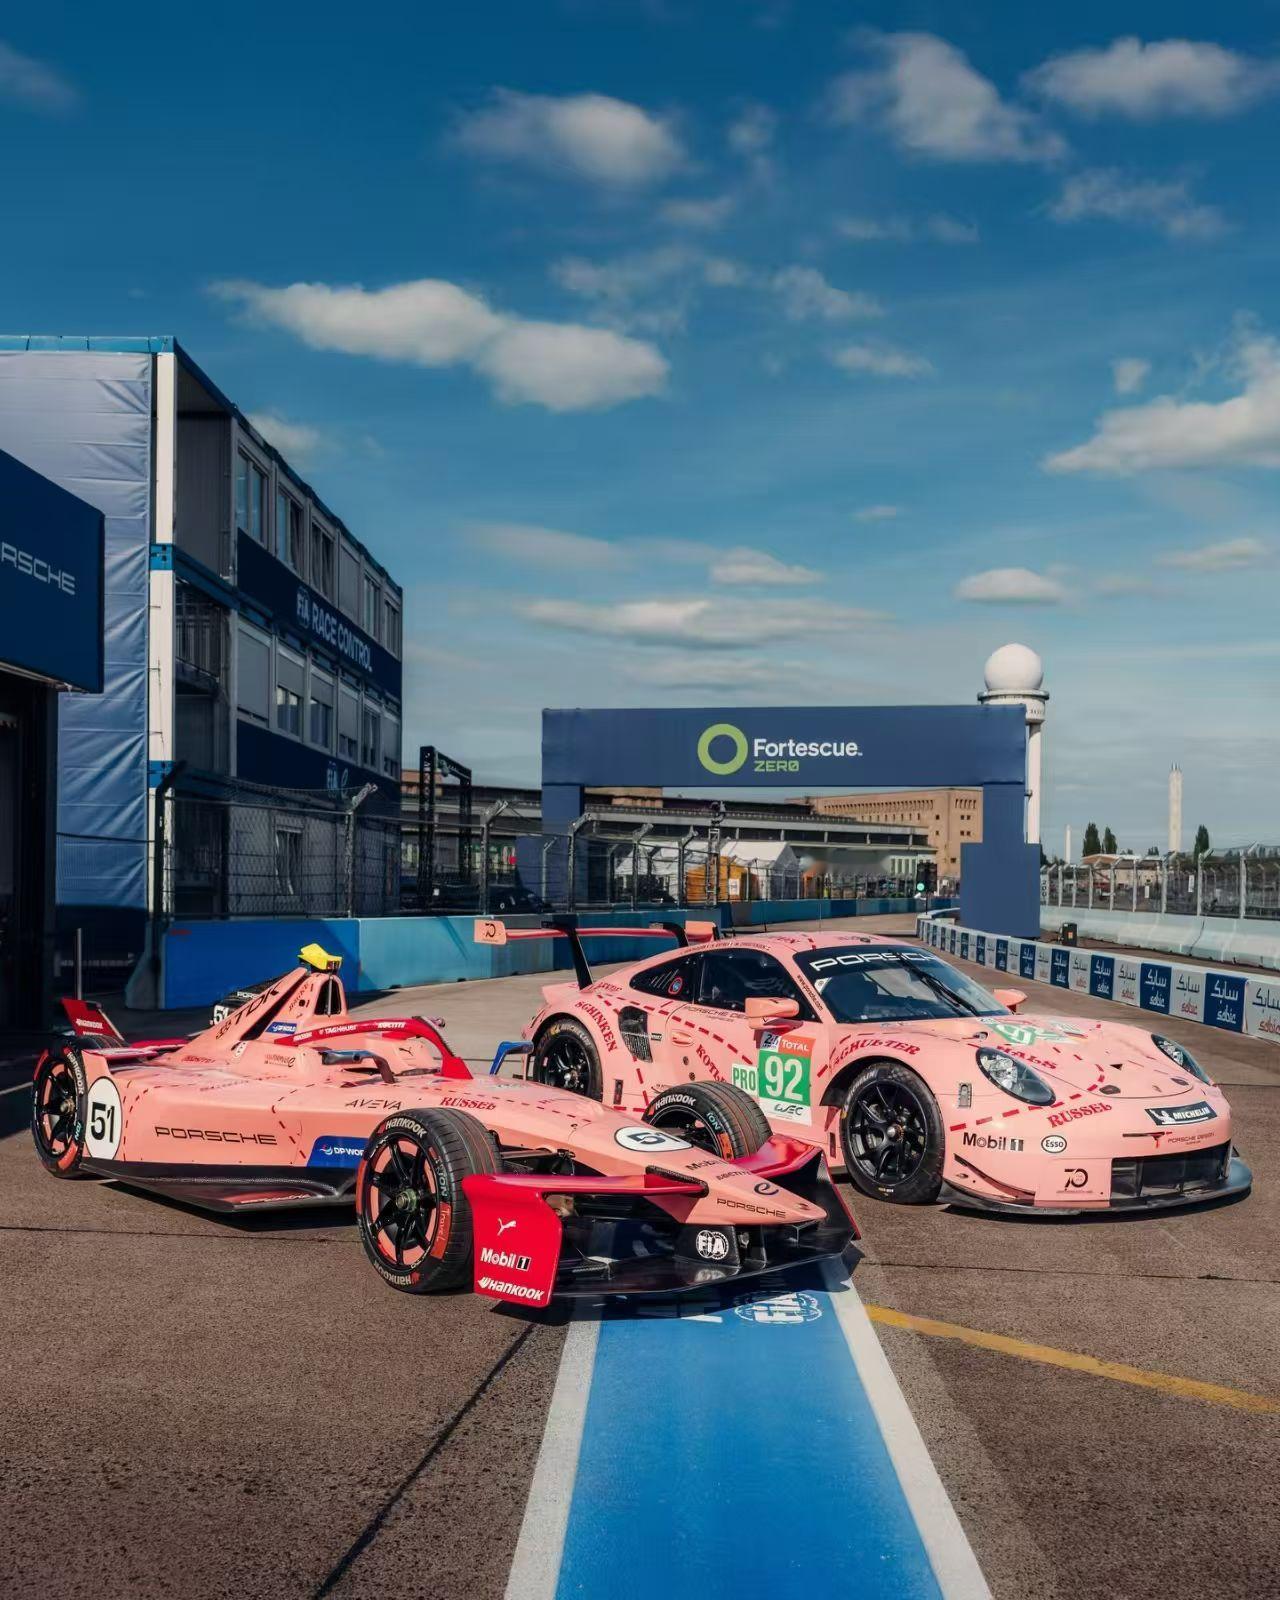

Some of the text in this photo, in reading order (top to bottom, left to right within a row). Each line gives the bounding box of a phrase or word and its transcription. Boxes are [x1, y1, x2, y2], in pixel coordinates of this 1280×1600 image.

[312, 602, 337, 646] RACE
[236, 979, 282, 1025] TDK
[574, 1002, 618, 1052] SCHINKEN
[782, 1039, 809, 1051] TOTAL
[833, 1039, 920, 1067] SCHULTER
[997, 1045, 1057, 1070] HALS
[733, 1067, 756, 1091] PRO
[764, 1055, 803, 1101] 92
[345, 1099, 402, 1110] AVEVA
[774, 1103, 803, 1116] WEC
[1047, 1102, 1113, 1128] RUSSEL
[1172, 1106, 1211, 1120] MICHELIN
[90, 1101, 115, 1143] 51
[154, 1126, 278, 1146] PORSCHE
[627, 1131, 681, 1145] 51
[962, 1131, 1007, 1151] Mobil
[1045, 1139, 1064, 1149] Esso
[1064, 1168, 1089, 1190] 70
[716, 1198, 787, 1219] PORSCHE
[698, 1233, 725, 1254] FIA
[481, 1247, 517, 1268] Mobil
